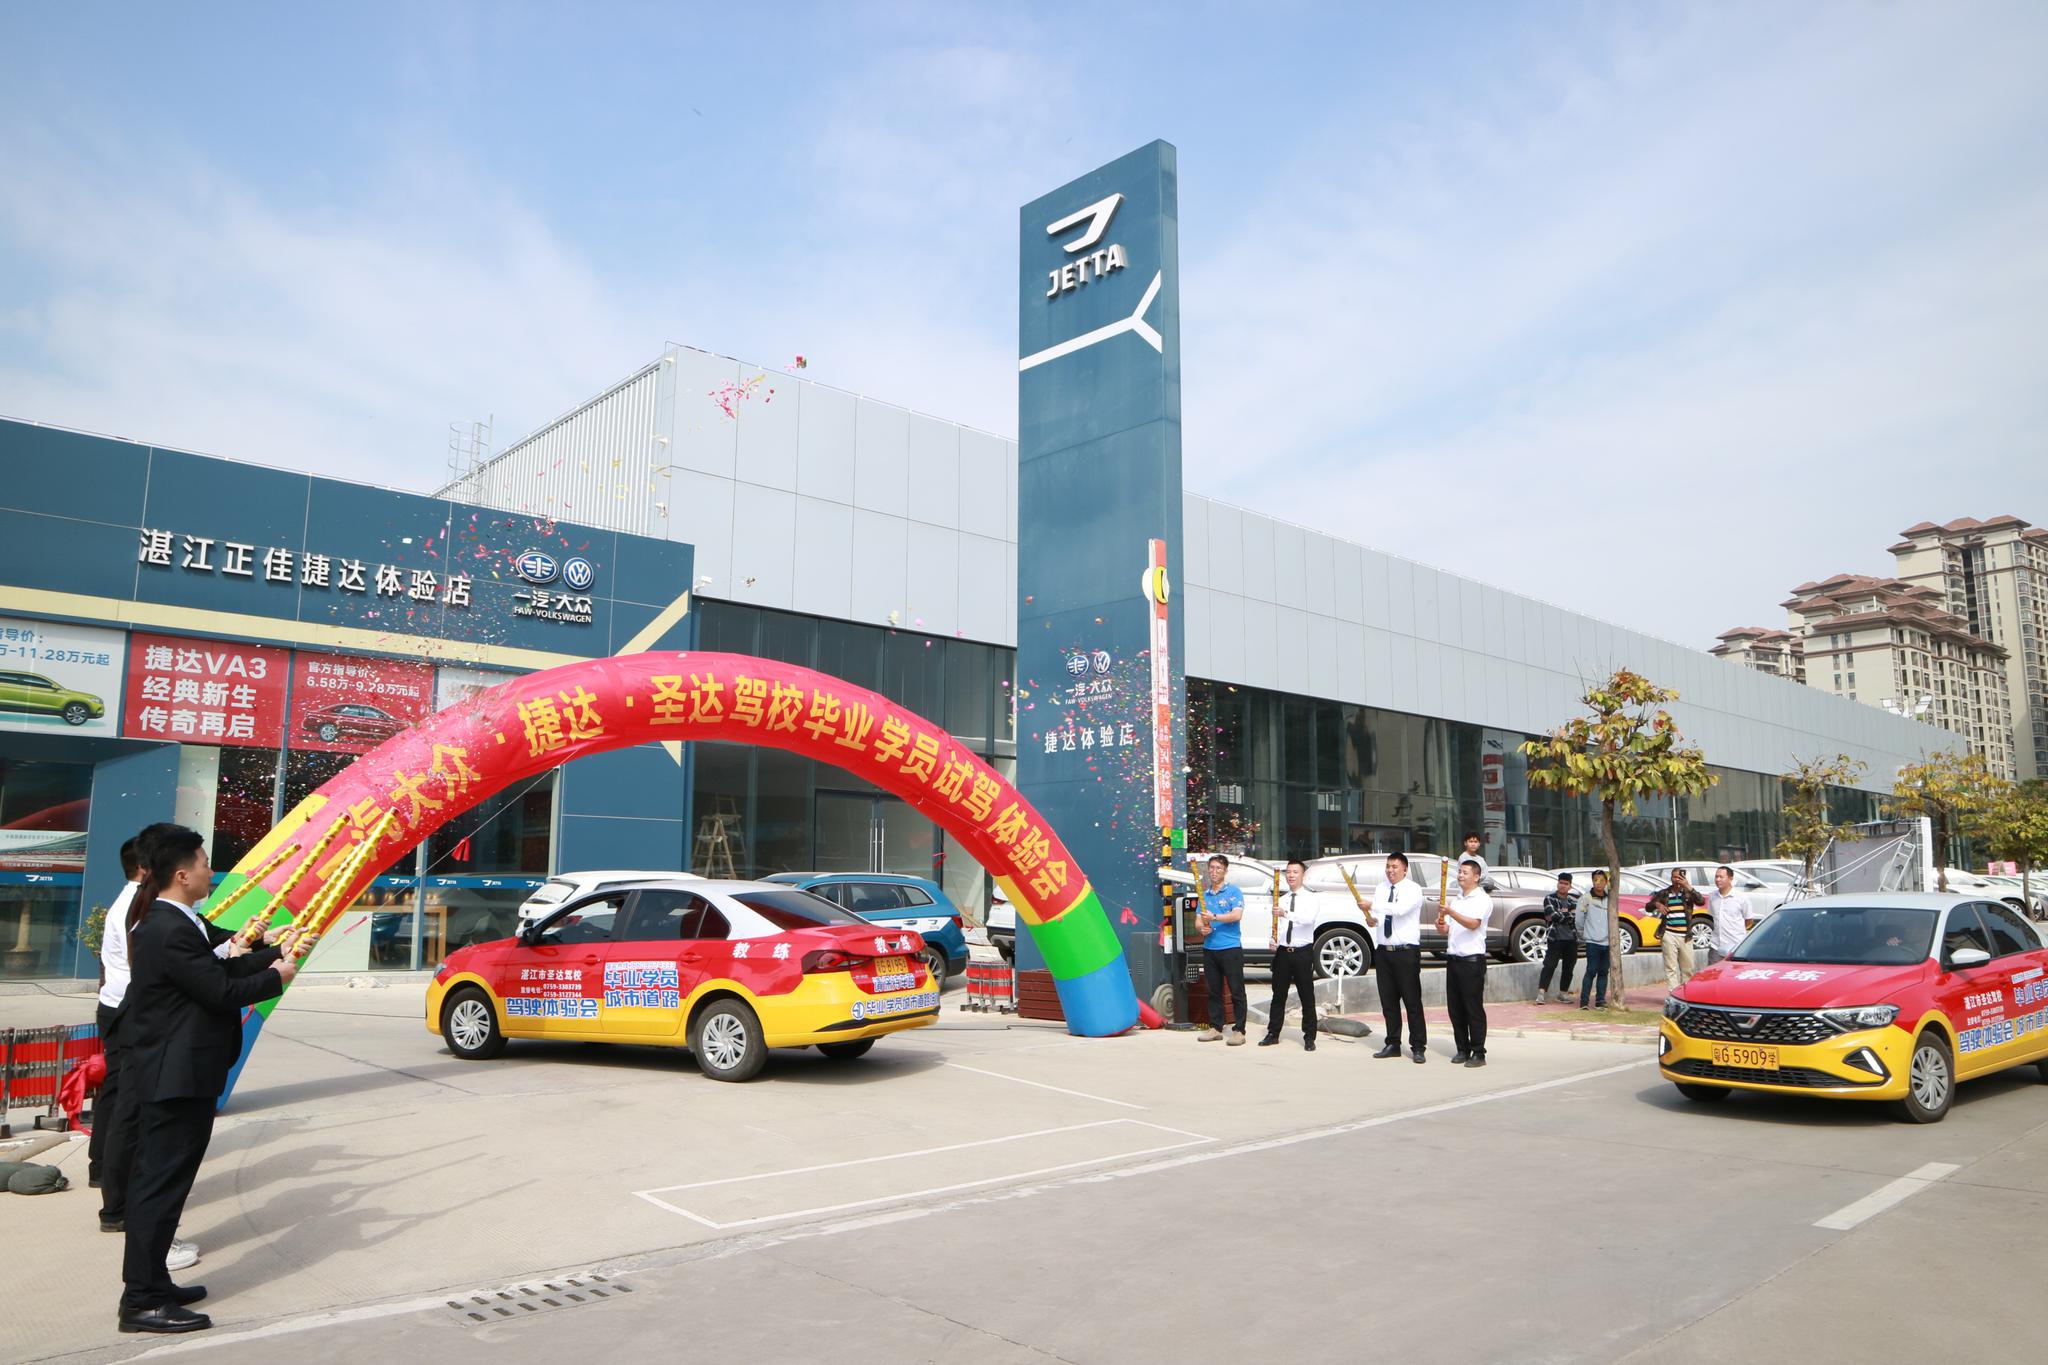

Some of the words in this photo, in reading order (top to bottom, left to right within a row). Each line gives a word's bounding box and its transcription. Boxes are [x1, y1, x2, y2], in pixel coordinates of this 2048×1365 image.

[1046, 243, 1127, 297] JETTA
[137, 528, 472, 607] 湛江正佳捷达体验店
[511, 589, 593, 614] 一汽-大众
[513, 605, 592, 623] FAW-VOLKSWAGEN
[144, 644, 267, 680] 捷达VA3
[141, 675, 257, 709] 经典新生
[139, 705, 255, 739] 传奇再启
[1044, 723, 1137, 754] 捷达体验店
[520, 968, 582, 981] 湛江市圣达驾校
[604, 970, 679, 989] 毕业学员
[506, 997, 599, 1018] 驾驶体验会
[605, 989, 679, 1008] 城市道路
[1959, 1019, 2015, 1054] 驾驶体验会
